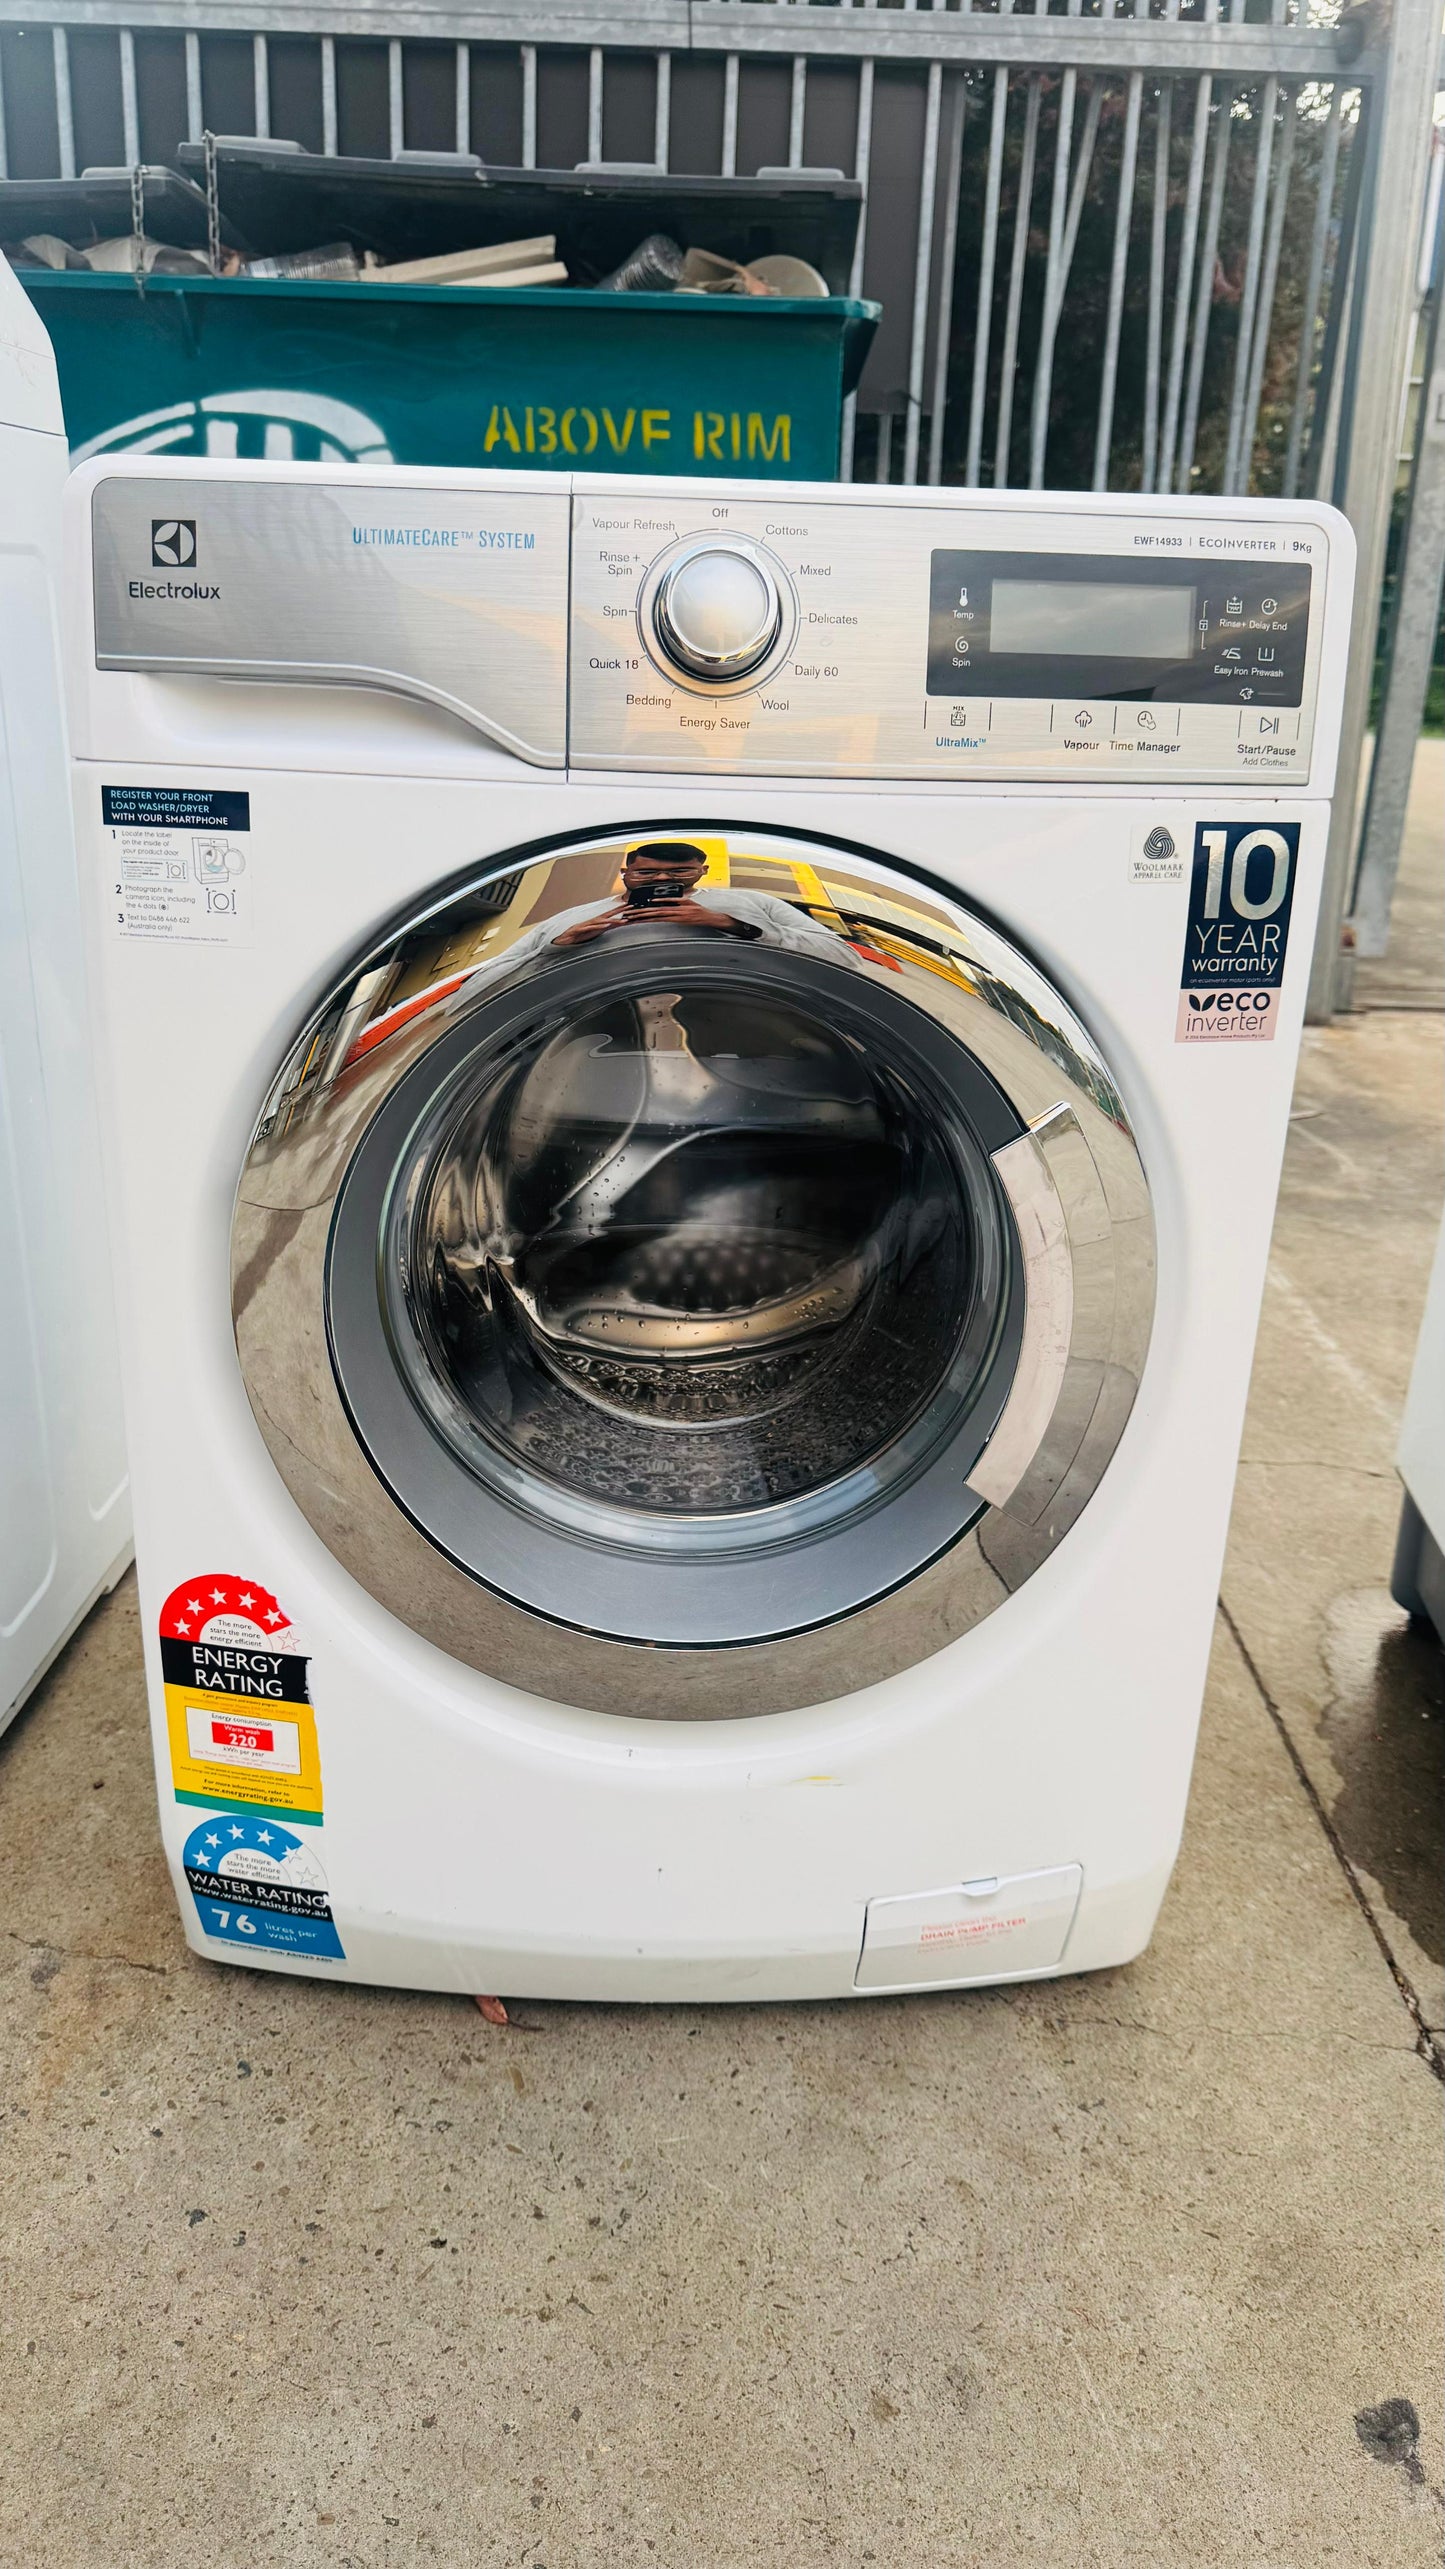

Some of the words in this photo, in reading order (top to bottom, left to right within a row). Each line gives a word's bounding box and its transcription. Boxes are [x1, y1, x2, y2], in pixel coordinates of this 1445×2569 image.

[693, 411, 791, 461] RIM
[712, 507, 729, 518] Off
[592, 518, 630, 531] Vapour
[633, 519, 675, 531] Refresh
[765, 525, 809, 536] Cottons
[1134, 536, 1183, 547] EWF14933
[599, 551, 630, 563] Rinse
[607, 564, 633, 577] Spin
[800, 565, 831, 576] Mixed
[129, 581, 221, 600] Electrolux
[603, 606, 628, 618] Spin
[952, 609, 974, 621] Temp
[808, 613, 858, 625] Delicates
[1249, 620, 1270, 632] Delay
[1272, 621, 1288, 631] End
[589, 658, 621, 670] Quick
[625, 659, 639, 669] 18
[952, 657, 971, 668] Spin
[795, 665, 820, 679] Daily
[824, 666, 839, 677] 60
[1214, 665, 1233, 676] Easy
[1234, 666, 1248, 676] Iron
[1251, 667, 1284, 677] Prewash
[626, 694, 671, 708] Bedding
[761, 699, 790, 711] Wool
[680, 716, 716, 730] Energy
[720, 717, 750, 729] Saver
[1064, 739, 1100, 752] Vapour
[1109, 740, 1134, 751] Time
[1137, 741, 1181, 754] Manager
[1237, 744, 1296, 757] Start/Pause
[1242, 757, 1258, 767] Add
[1260, 758, 1288, 768] Clothes
[110, 789, 152, 800] REGISTER
[154, 791, 180, 801] YOUR
[183, 792, 213, 802] FRONT
[111, 801, 136, 810] LOAD
[138, 803, 210, 814] WASHER/DRYER
[111, 812, 135, 821] WITH
[137, 813, 163, 823] YOUR
[165, 815, 229, 825] SMARTPHONE
[112, 829, 116, 839] 1
[121, 830, 142, 838] Locate
[144, 830, 154, 838] the
[132, 838, 142, 846] the
[143, 839, 161, 847] inside
[137, 848, 163, 857] product
[1133, 862, 1184, 872] WOOLMARK
[1202, 829, 1290, 920] 10
[115, 884, 122, 894] 2
[125, 885, 162, 895] Photograph
[163, 886, 174, 894] the
[125, 894, 150, 902] camera
[167, 896, 196, 905] including
[117, 913, 125, 923] 3
[127, 913, 143, 922] Text
[143, 914, 148, 922] to
[179, 916, 190, 924] 622
[127, 922, 157, 931] (Australia
[1195, 924, 1281, 954] YEAR
[1191, 954, 1279, 976] warranty
[1216, 992, 1271, 1012] eco
[1186, 1012, 1268, 1032] inverter
[217, 1619, 232, 1627] The
[232, 1622, 252, 1630] more
[209, 1627, 226, 1635] stars
[228, 1629, 240, 1637] the
[209, 1636, 233, 1645] energy
[235, 1638, 263, 1647] efficient
[192, 1646, 283, 1675] ENERGY
[195, 1668, 283, 1697] RATING
[211, 1713, 232, 1722] Energy
[233, 1716, 272, 1728] consumption
[223, 1724, 244, 1734] Warm
[245, 1728, 261, 1736] wash
[229, 1733, 257, 1749] 220
[223, 1746, 239, 1754] kWh
[239, 1748, 250, 1756] per
[251, 1750, 265, 1758] year
[202, 1786, 294, 1805] www.energyrating.gov.au
[267, 1788, 282, 1796] refer
[235, 1853, 249, 1862] The
[250, 1857, 272, 1866] more
[226, 1860, 245, 1869] stars
[246, 1862, 259, 1870] the
[260, 1865, 281, 1874] more
[228, 1867, 249, 1876] water
[251, 1870, 281, 1881] efficient
[189, 1871, 252, 1896] WATER
[192, 1884, 328, 1918] www.waterrating.gov.au
[211, 1908, 257, 1935] 76
[264, 1922, 294, 1935] litres
[297, 1926, 318, 1938] per
[920, 1929, 954, 1941] DRAIN
[991, 1917, 1026, 1929] FILTER
[268, 1931, 297, 1943] wash
